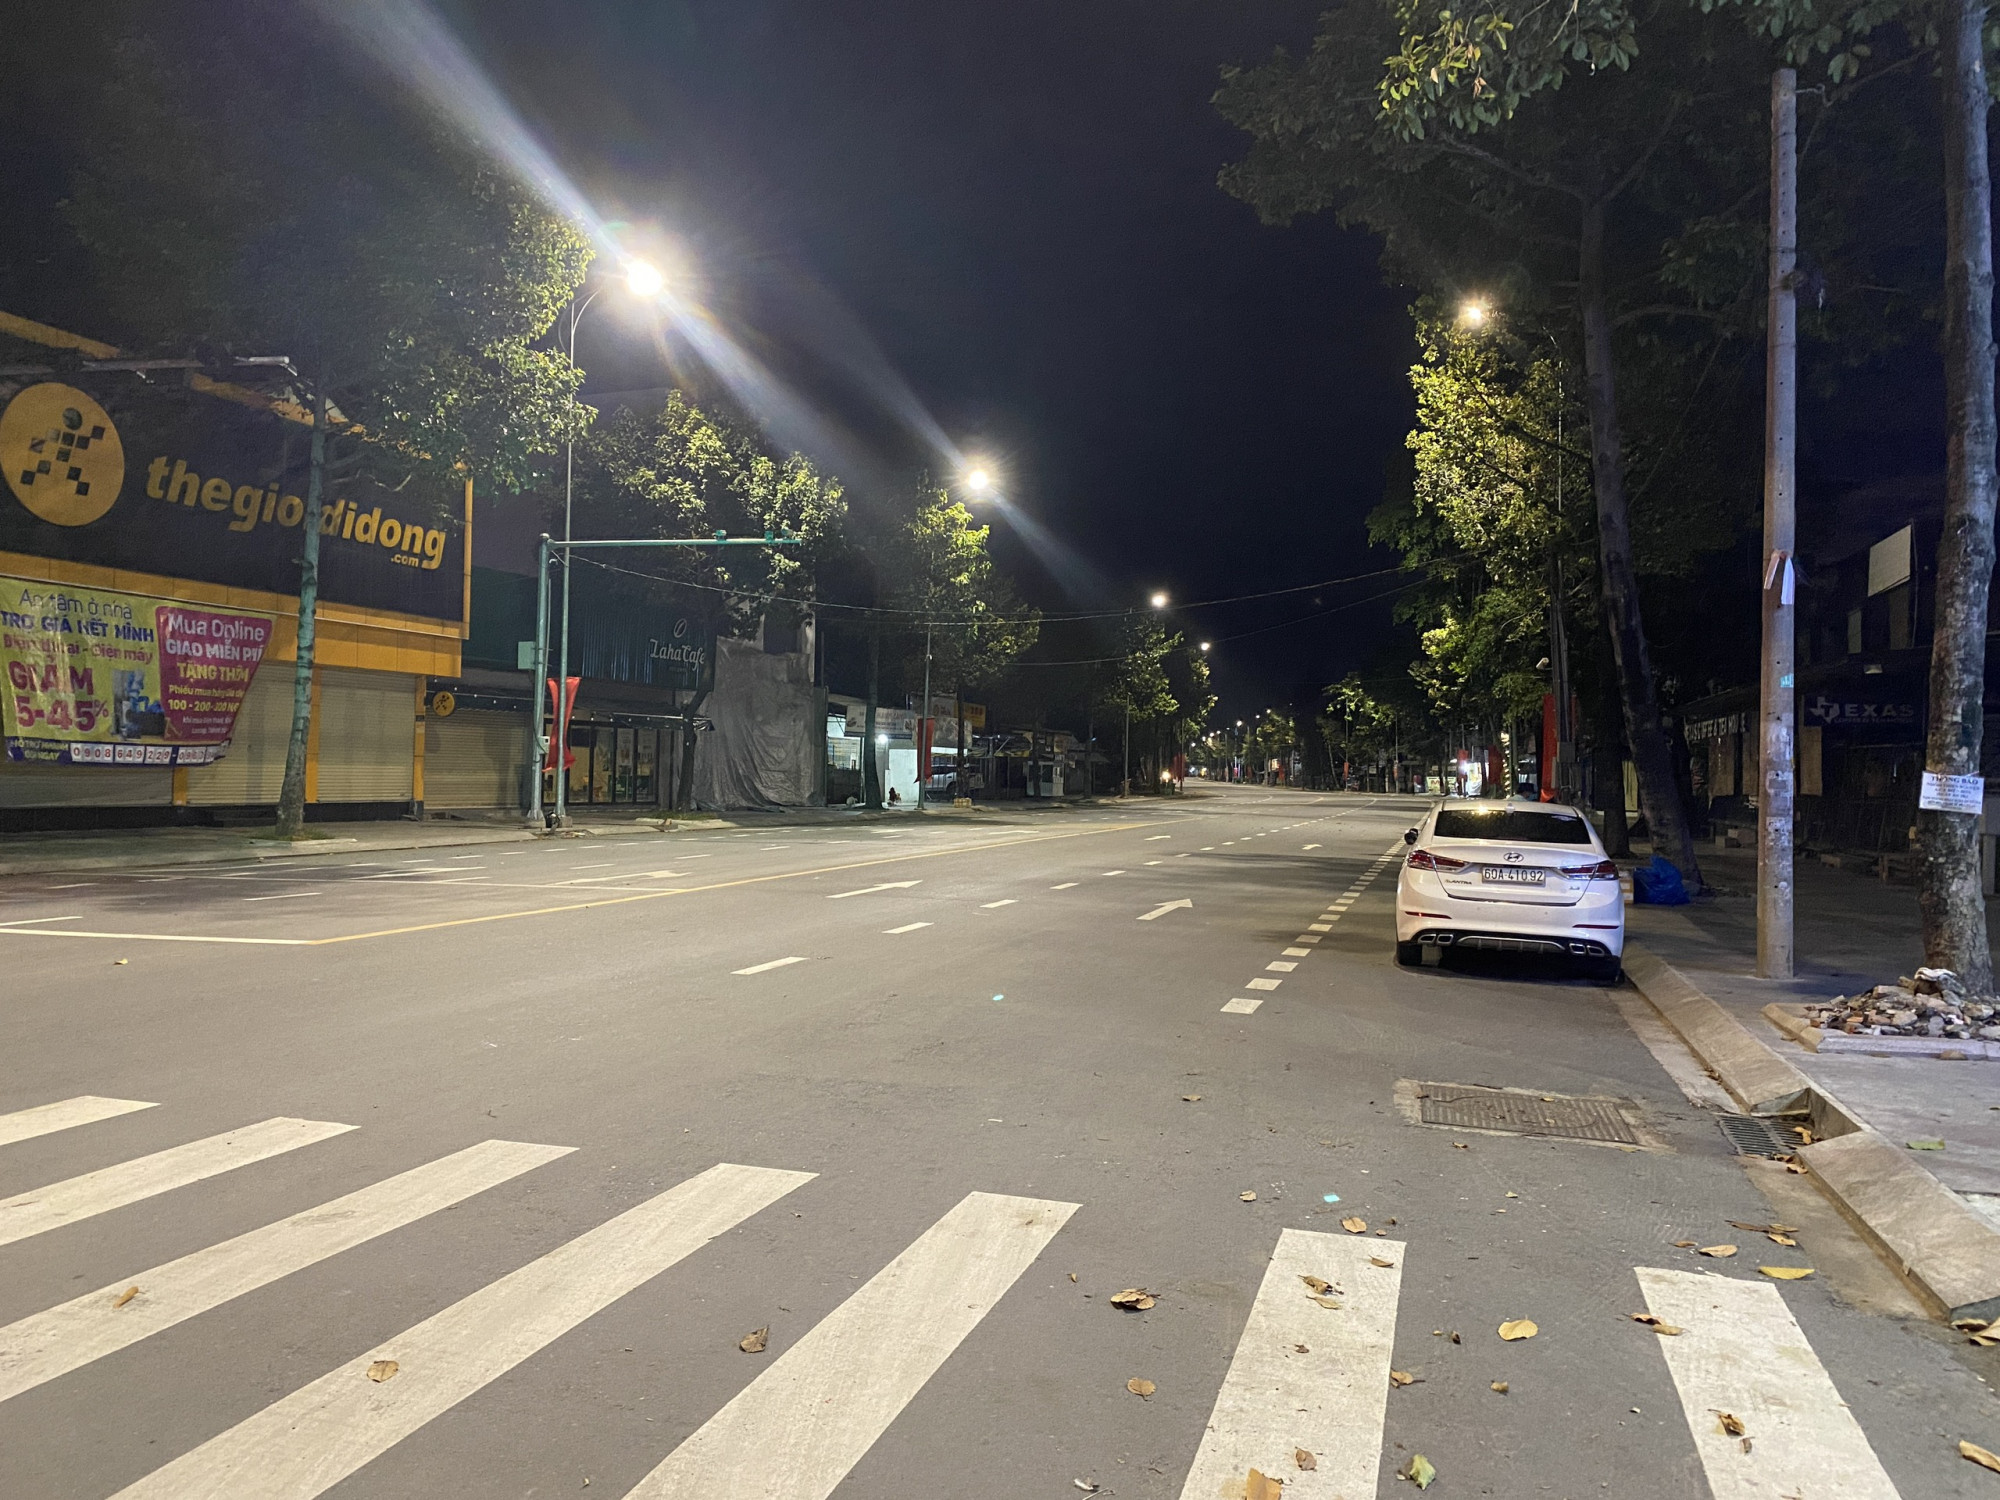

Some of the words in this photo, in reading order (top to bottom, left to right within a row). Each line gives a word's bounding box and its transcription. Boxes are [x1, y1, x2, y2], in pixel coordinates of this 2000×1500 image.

[147, 456, 446, 569] thegiodidong
[391, 553, 419, 567] .com
[41, 614, 73, 634] GIÁ
[114, 621, 154, 643] MÌNH
[168, 613, 207, 636] Mua
[211, 619, 265, 641] Online
[166, 639, 203, 657] GIAO
[168, 699, 187, 710] 100
[1484, 867, 1544, 882] 60A-410.92
